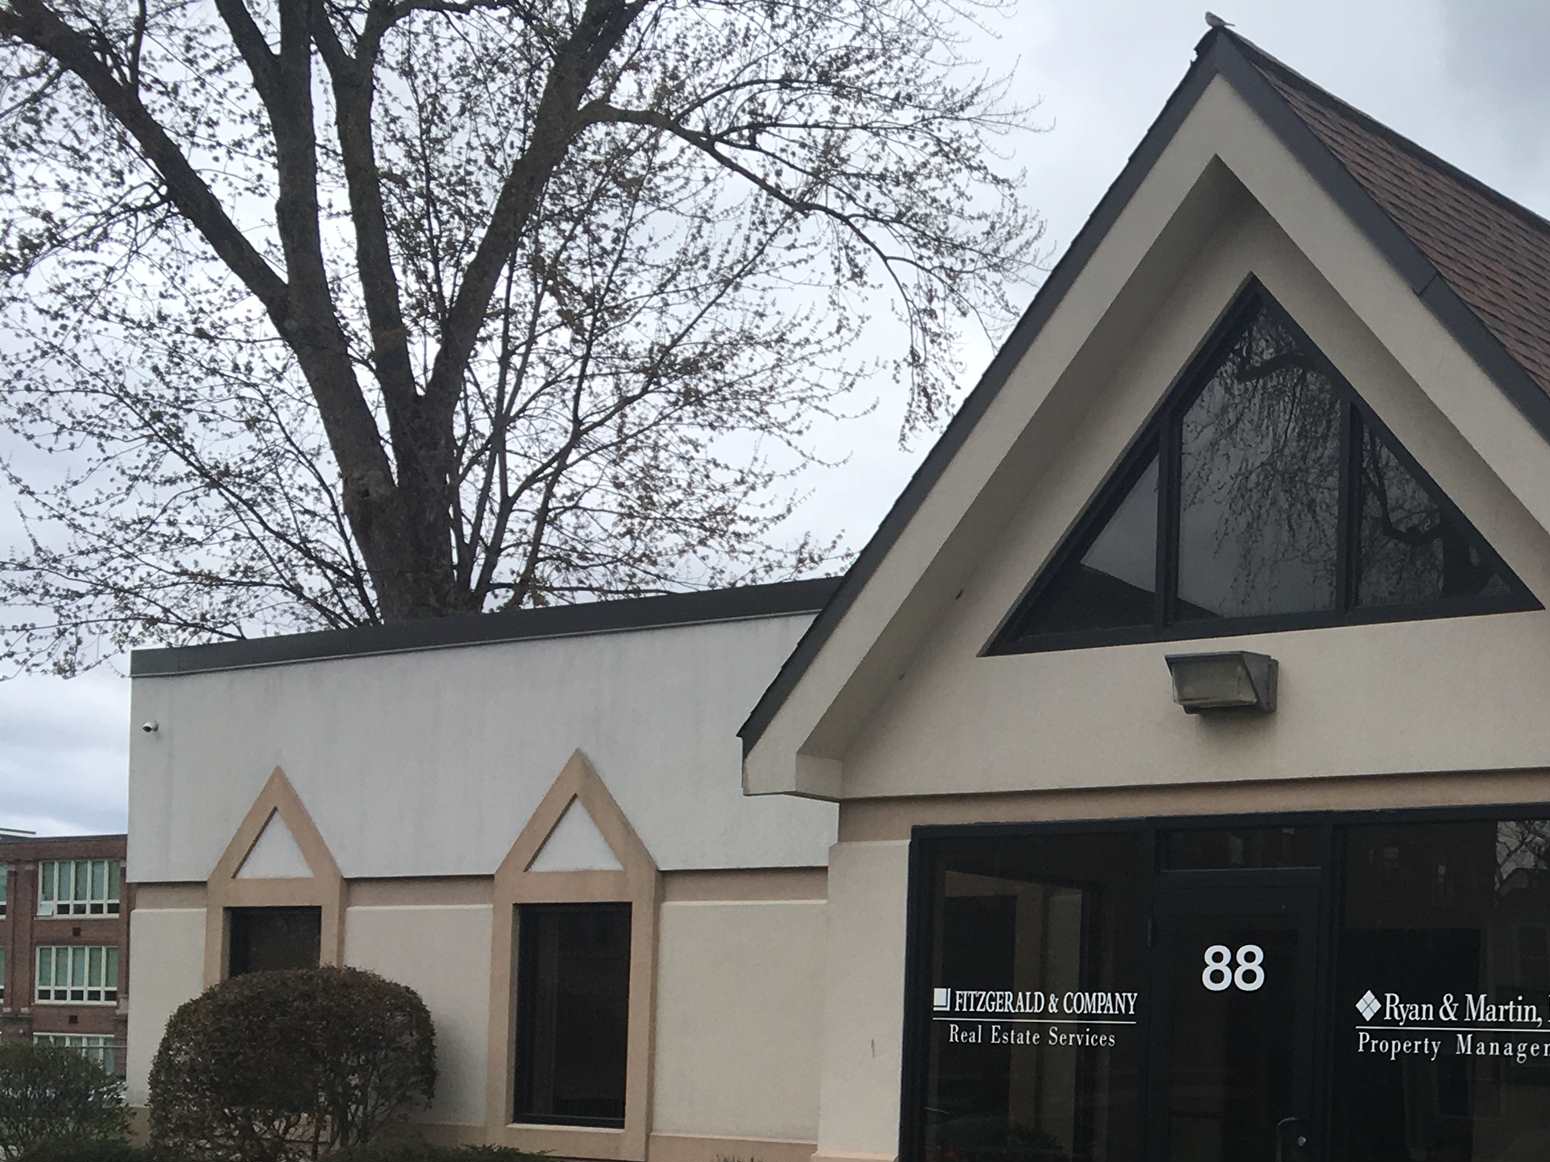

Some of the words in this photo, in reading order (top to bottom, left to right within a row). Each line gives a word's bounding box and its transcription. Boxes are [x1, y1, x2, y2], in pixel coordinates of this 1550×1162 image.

[1201, 944, 1266, 992] 88
[954, 990, 1044, 1014] FITZGERALD
[1048, 993, 1060, 1013] &
[1063, 992, 1138, 1016] COMPANY
[1384, 992, 1434, 1026] Ryan
[1438, 993, 1459, 1021] &
[1464, 993, 1543, 1028] Martin,
[949, 1023, 983, 1044] Real
[991, 1025, 1040, 1046] Estate
[1048, 1026, 1116, 1047] Services
[1358, 1031, 1442, 1062] Property
